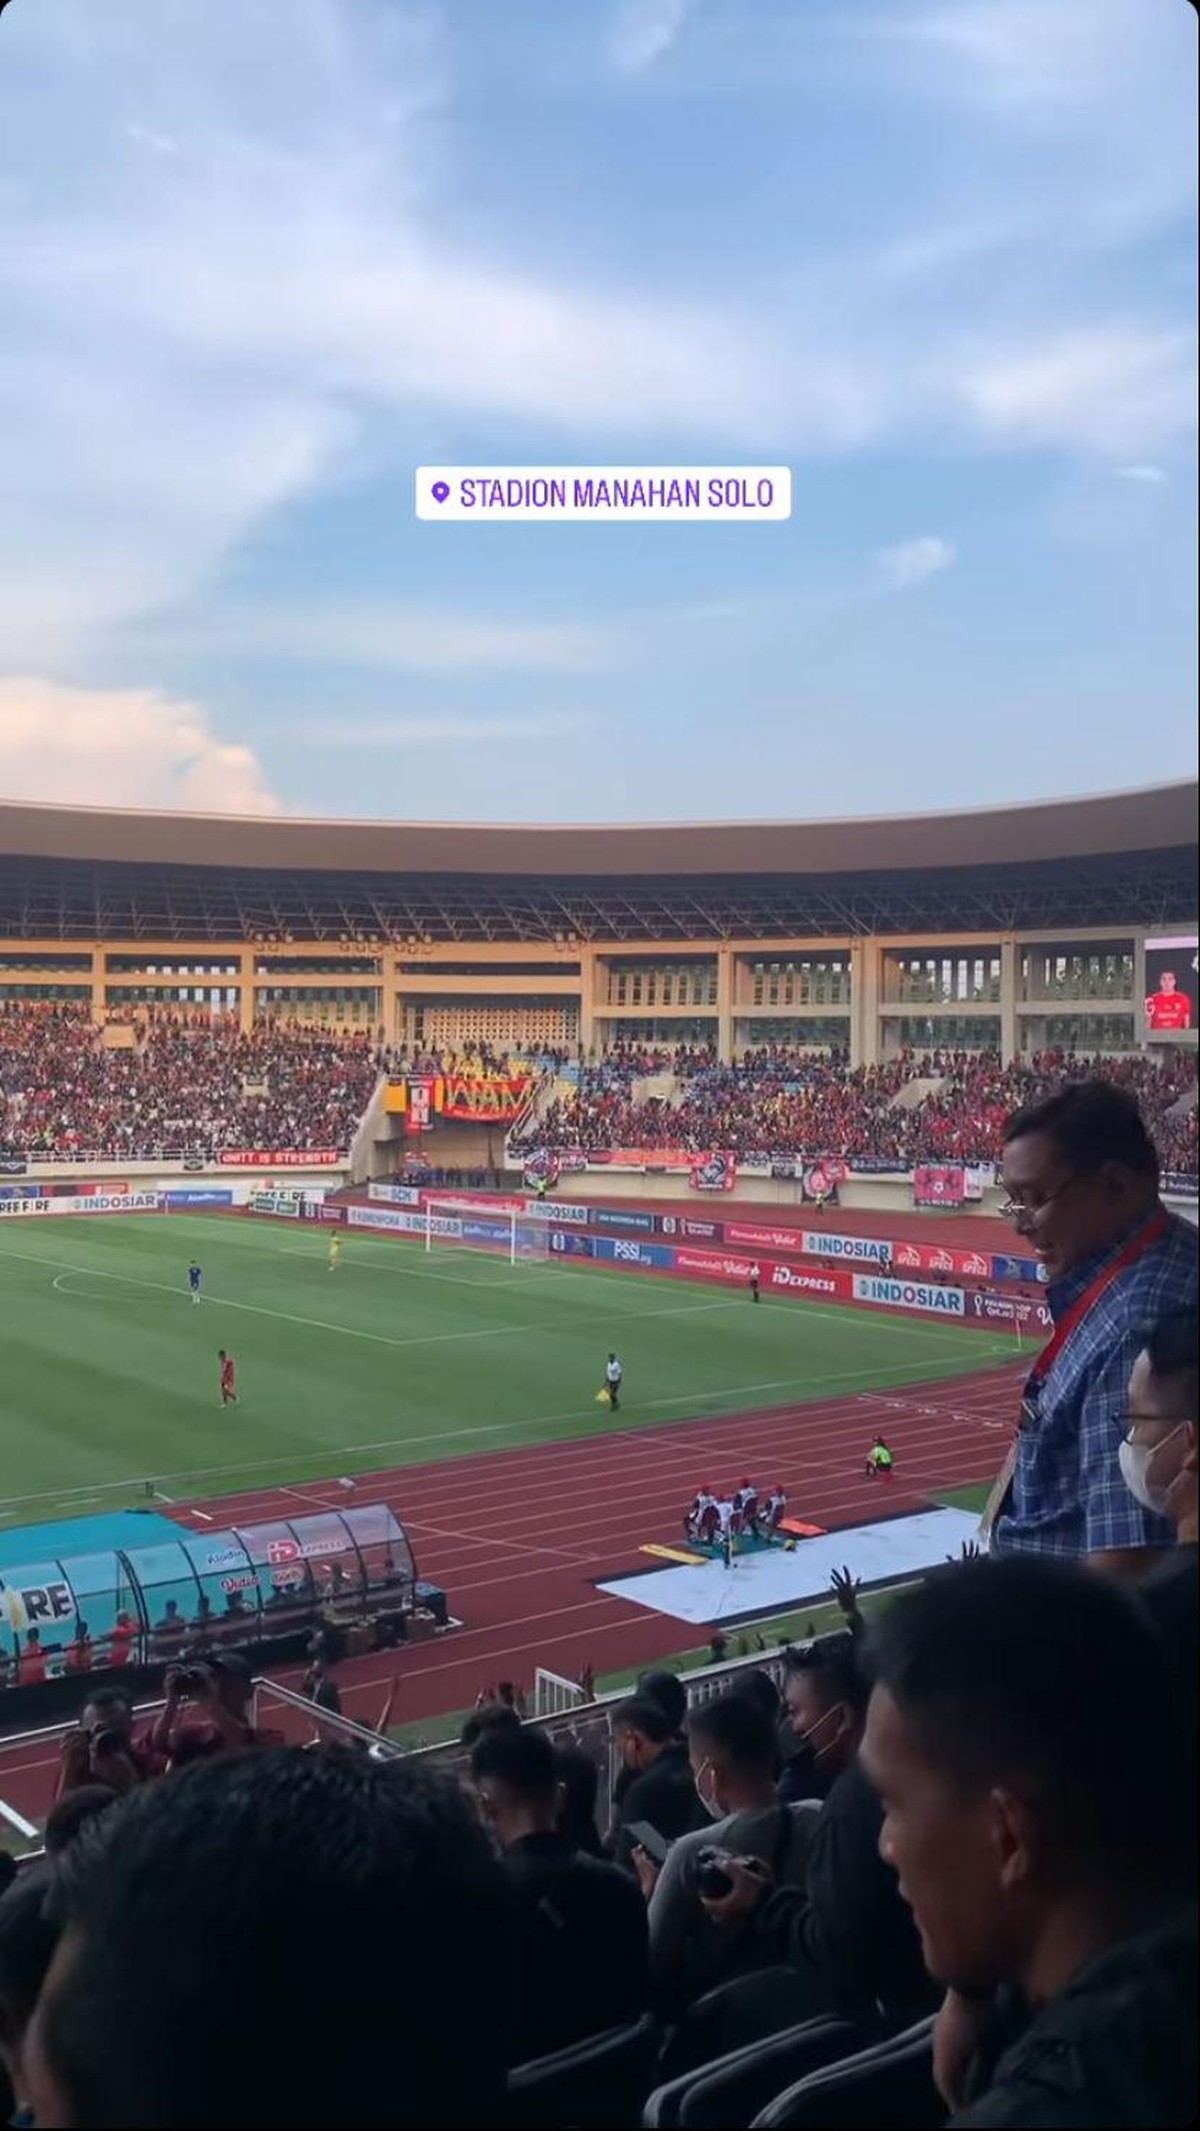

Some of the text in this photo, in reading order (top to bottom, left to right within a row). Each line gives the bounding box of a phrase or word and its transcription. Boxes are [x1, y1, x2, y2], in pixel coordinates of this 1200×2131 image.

[84, 1195, 156, 1209] INDOSIAR
[818, 1236, 890, 1262] INDOSIAR
[872, 1278, 962, 1312] INDOSIAR
